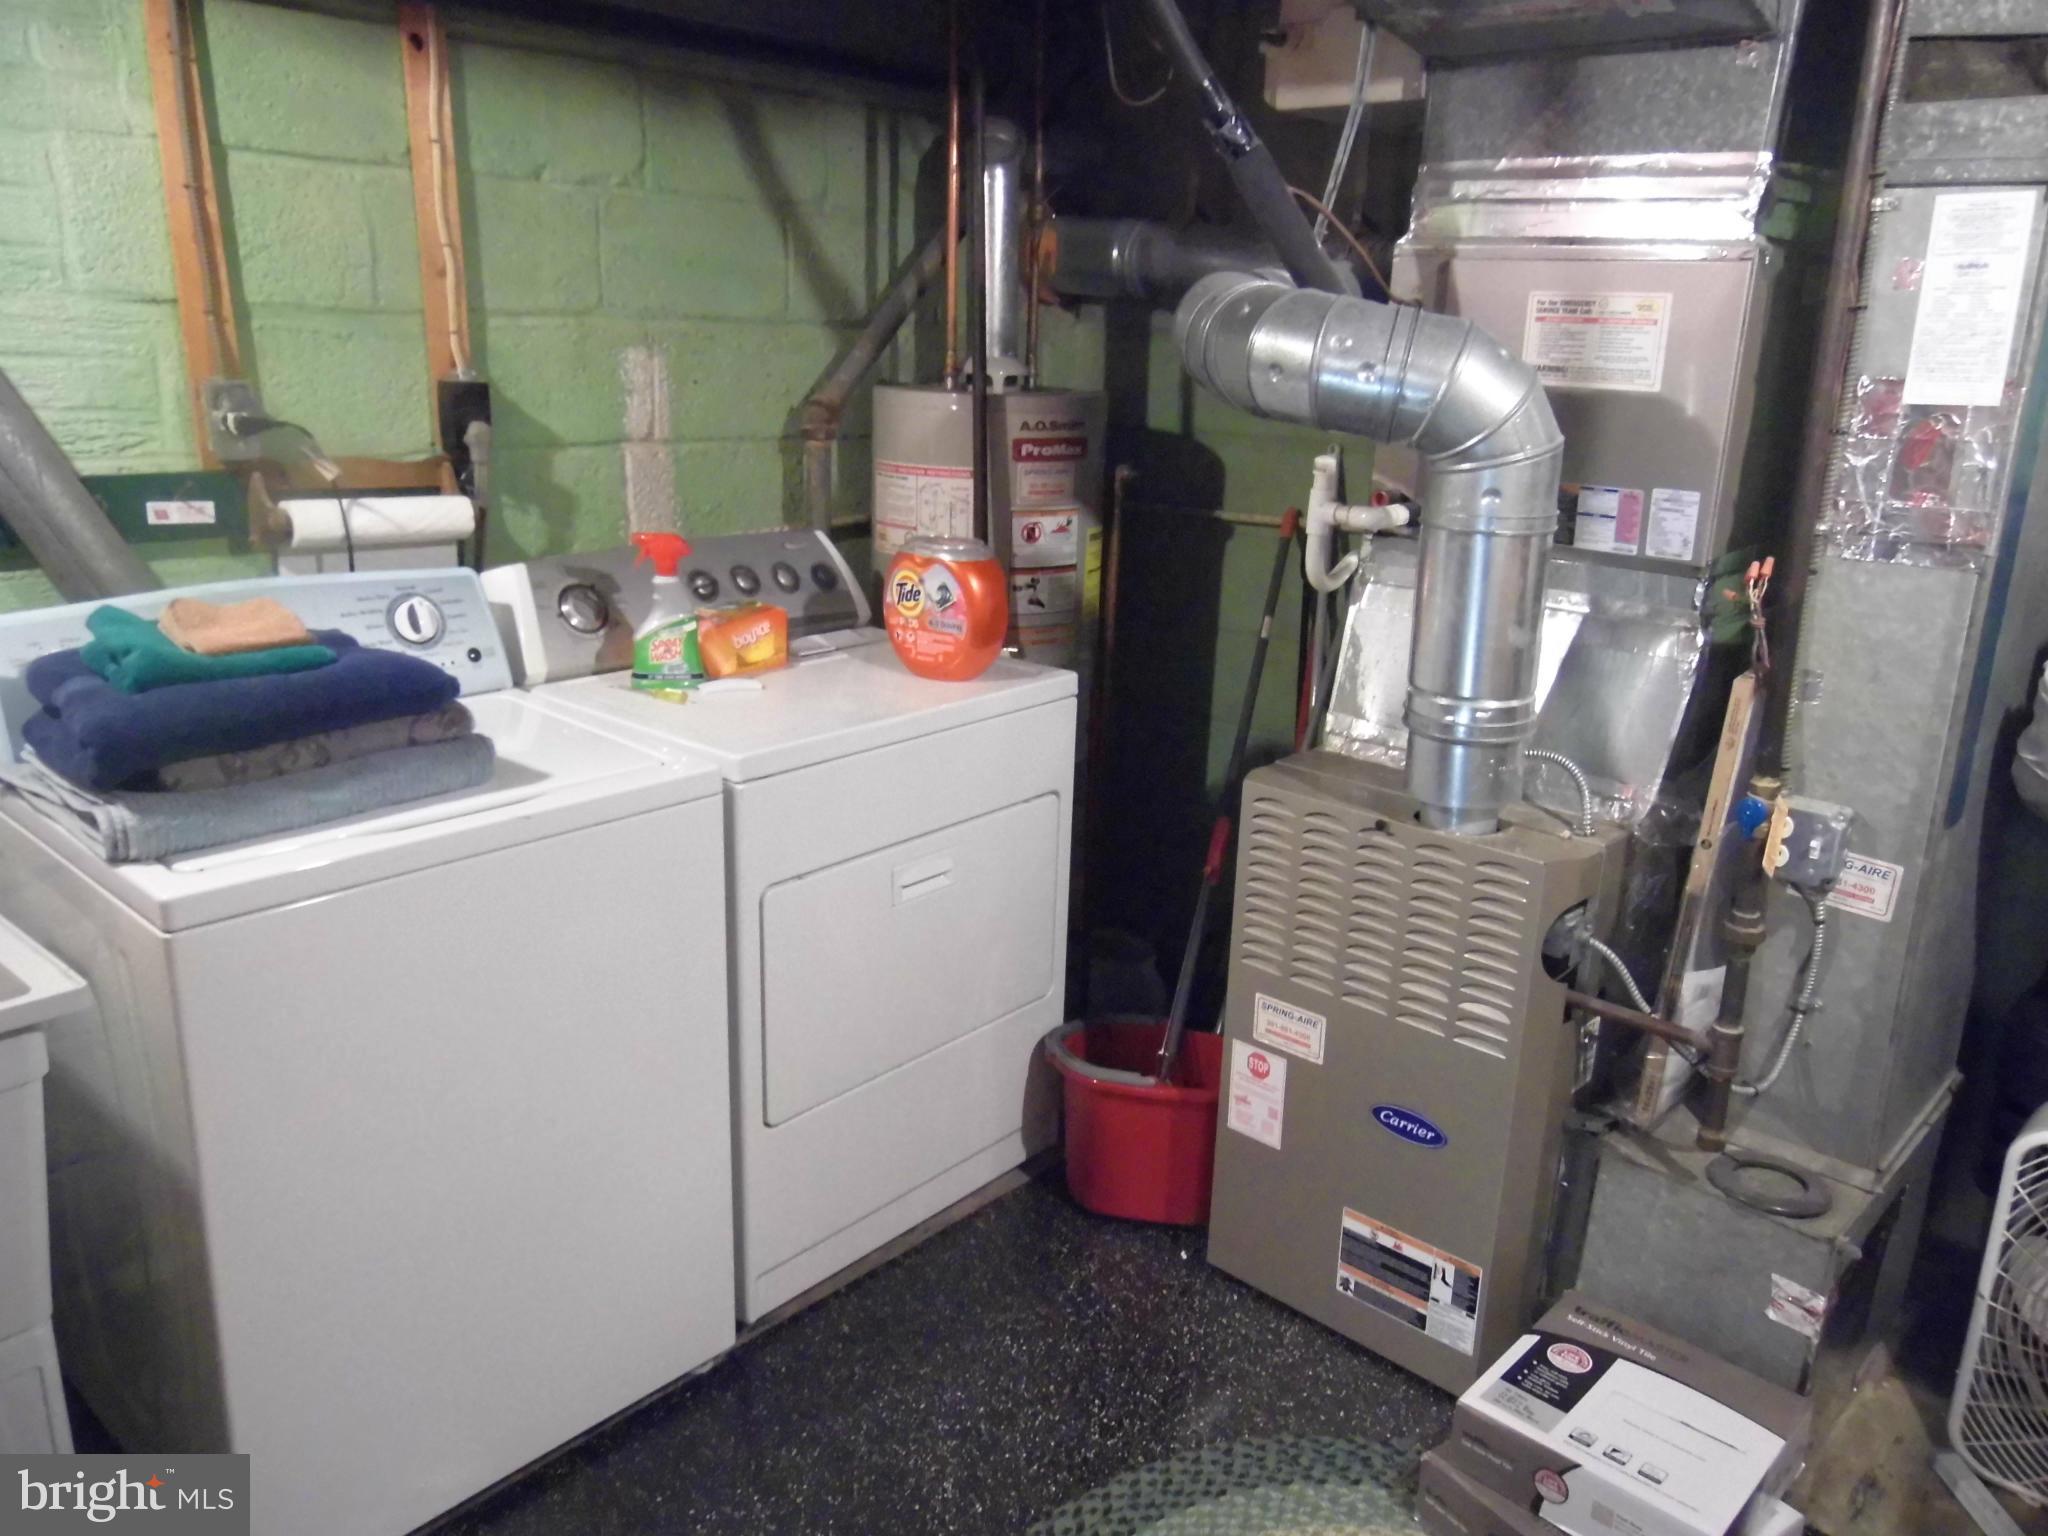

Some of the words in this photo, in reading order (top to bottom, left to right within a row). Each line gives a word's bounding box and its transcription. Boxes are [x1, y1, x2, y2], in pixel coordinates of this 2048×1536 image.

[1020, 443, 1082, 457] ProMax
[896, 582, 921, 606] Tide
[732, 620, 771, 649] bounce
[1262, 1001, 1319, 1030] SPRING-AIRE
[1248, 1056, 1270, 1074] STOP
[1380, 1110, 1435, 1140] Carrier
[1612, 1335, 1638, 1352] Vinyl
[1639, 1347, 1657, 1361] Tile
